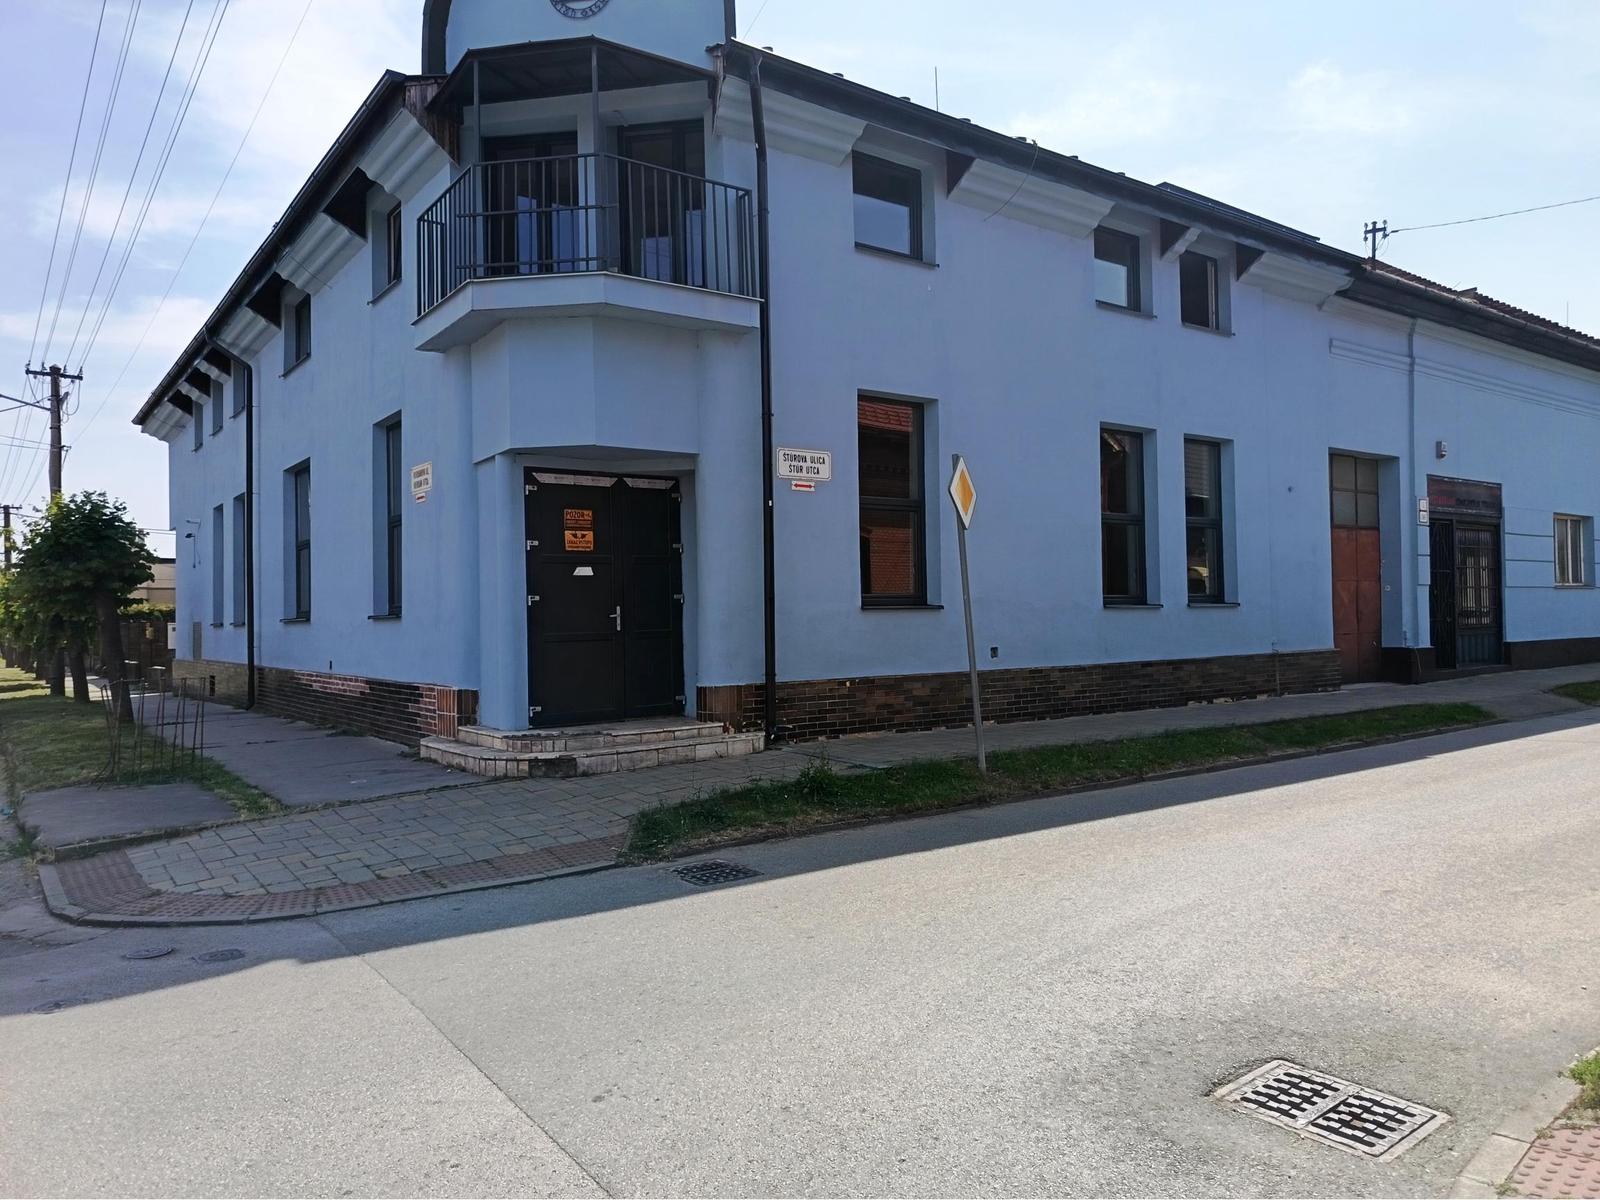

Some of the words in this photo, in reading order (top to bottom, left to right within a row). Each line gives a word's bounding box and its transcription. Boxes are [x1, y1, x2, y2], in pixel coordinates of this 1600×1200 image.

[810, 455, 825, 465] ULICA
[806, 466, 820, 475] UTCA
[565, 511, 585, 519] POZOR
